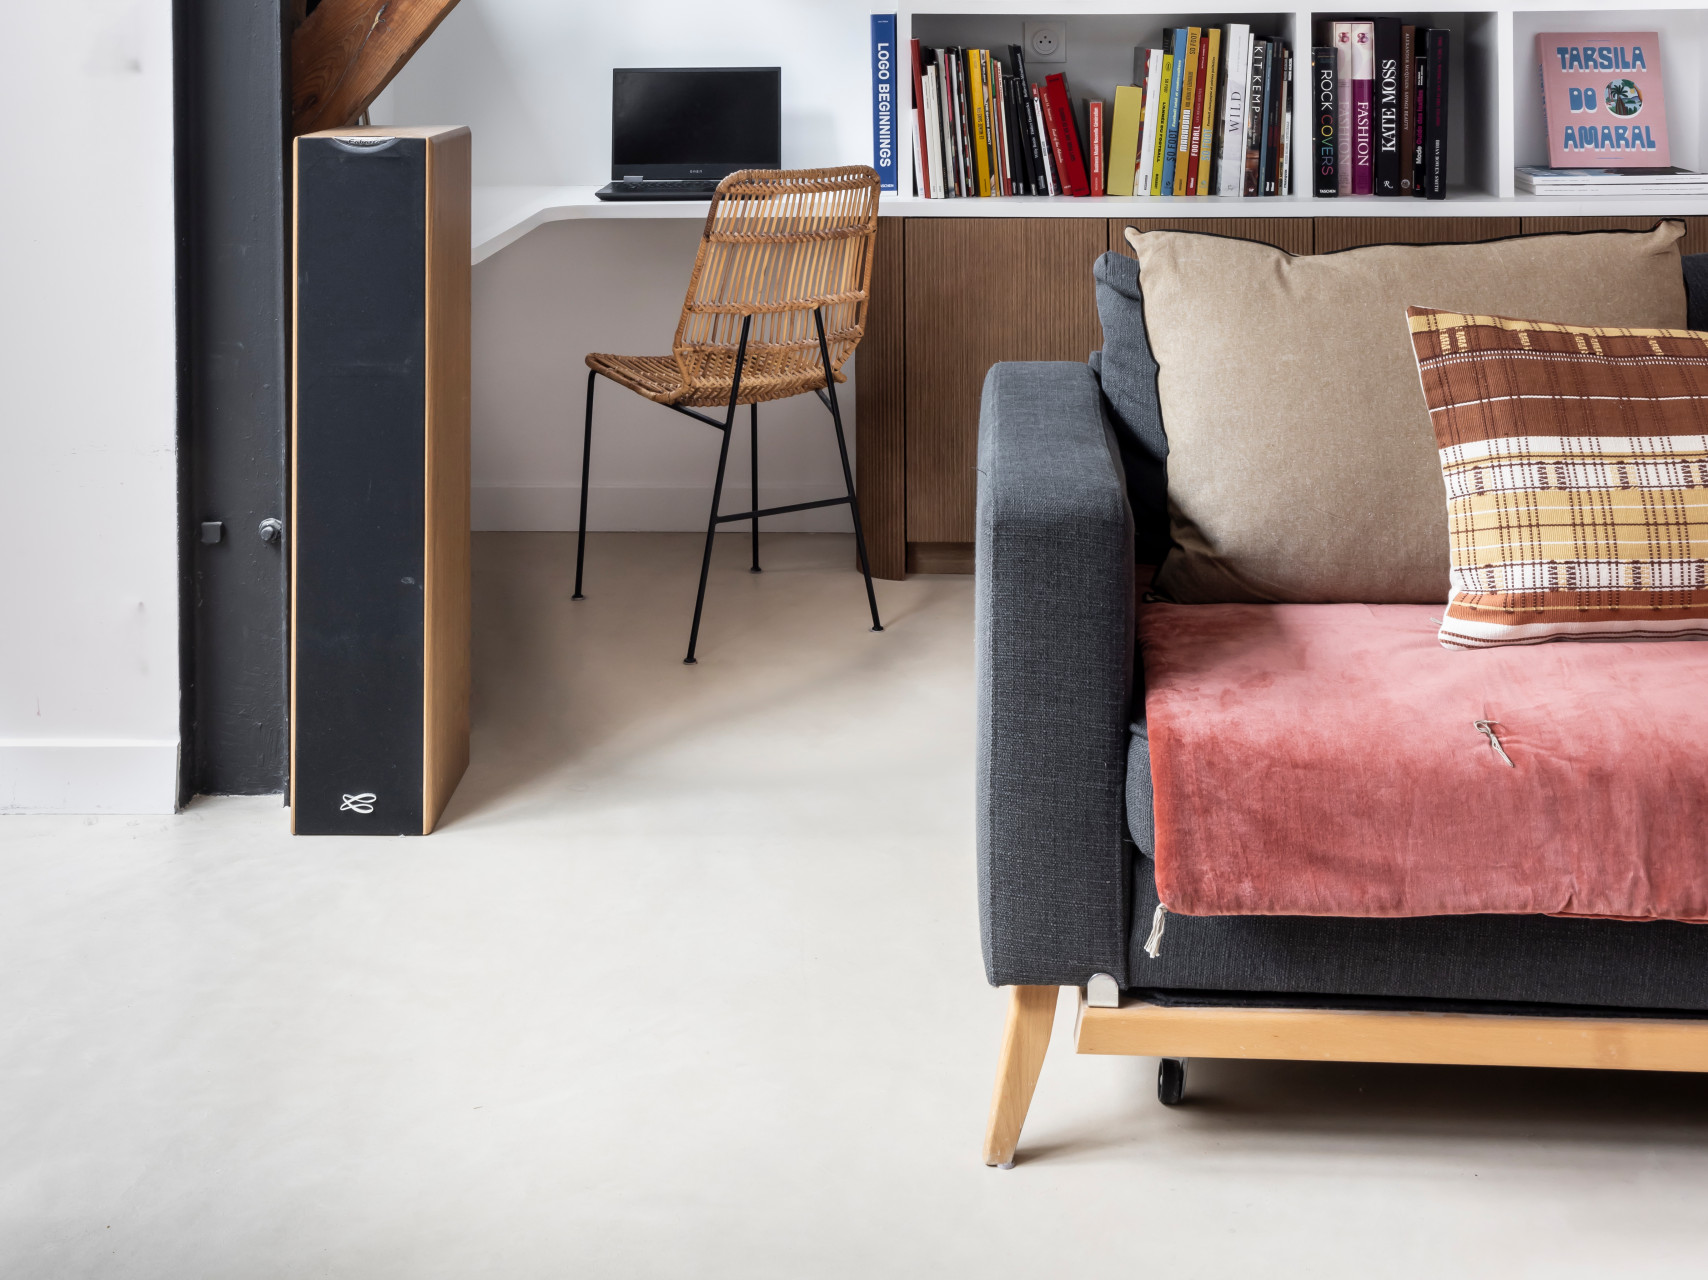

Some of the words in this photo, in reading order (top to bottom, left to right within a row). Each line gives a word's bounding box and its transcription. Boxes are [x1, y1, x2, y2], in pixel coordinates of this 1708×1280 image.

[1188, 46, 1196, 55] SO
[1189, 32, 1197, 45] FOOT
[877, 42, 890, 80] LOGO
[1253, 46, 1263, 69] KIT
[1556, 46, 1647, 73] TARSILA
[1252, 75, 1262, 113] KEMP
[1321, 70, 1333, 111] ROCK
[1382, 59, 1397, 104] MOSS
[1229, 91, 1242, 132] WILD
[1568, 87, 1598, 113] DO
[879, 83, 892, 168] BEGINNINGS
[1168, 129, 1177, 149] FOOT
[1180, 109, 1190, 152] MARADONA
[1191, 125, 1200, 157] FOOTBALL
[1202, 128, 1212, 149] FOOT
[1357, 101, 1369, 166] FASHION
[1381, 108, 1396, 153] KATE
[1563, 125, 1657, 152] AMARAL
[1166, 151, 1175, 162] SO
[1201, 150, 1210, 161] SO
[1321, 114, 1333, 176] COVERS
